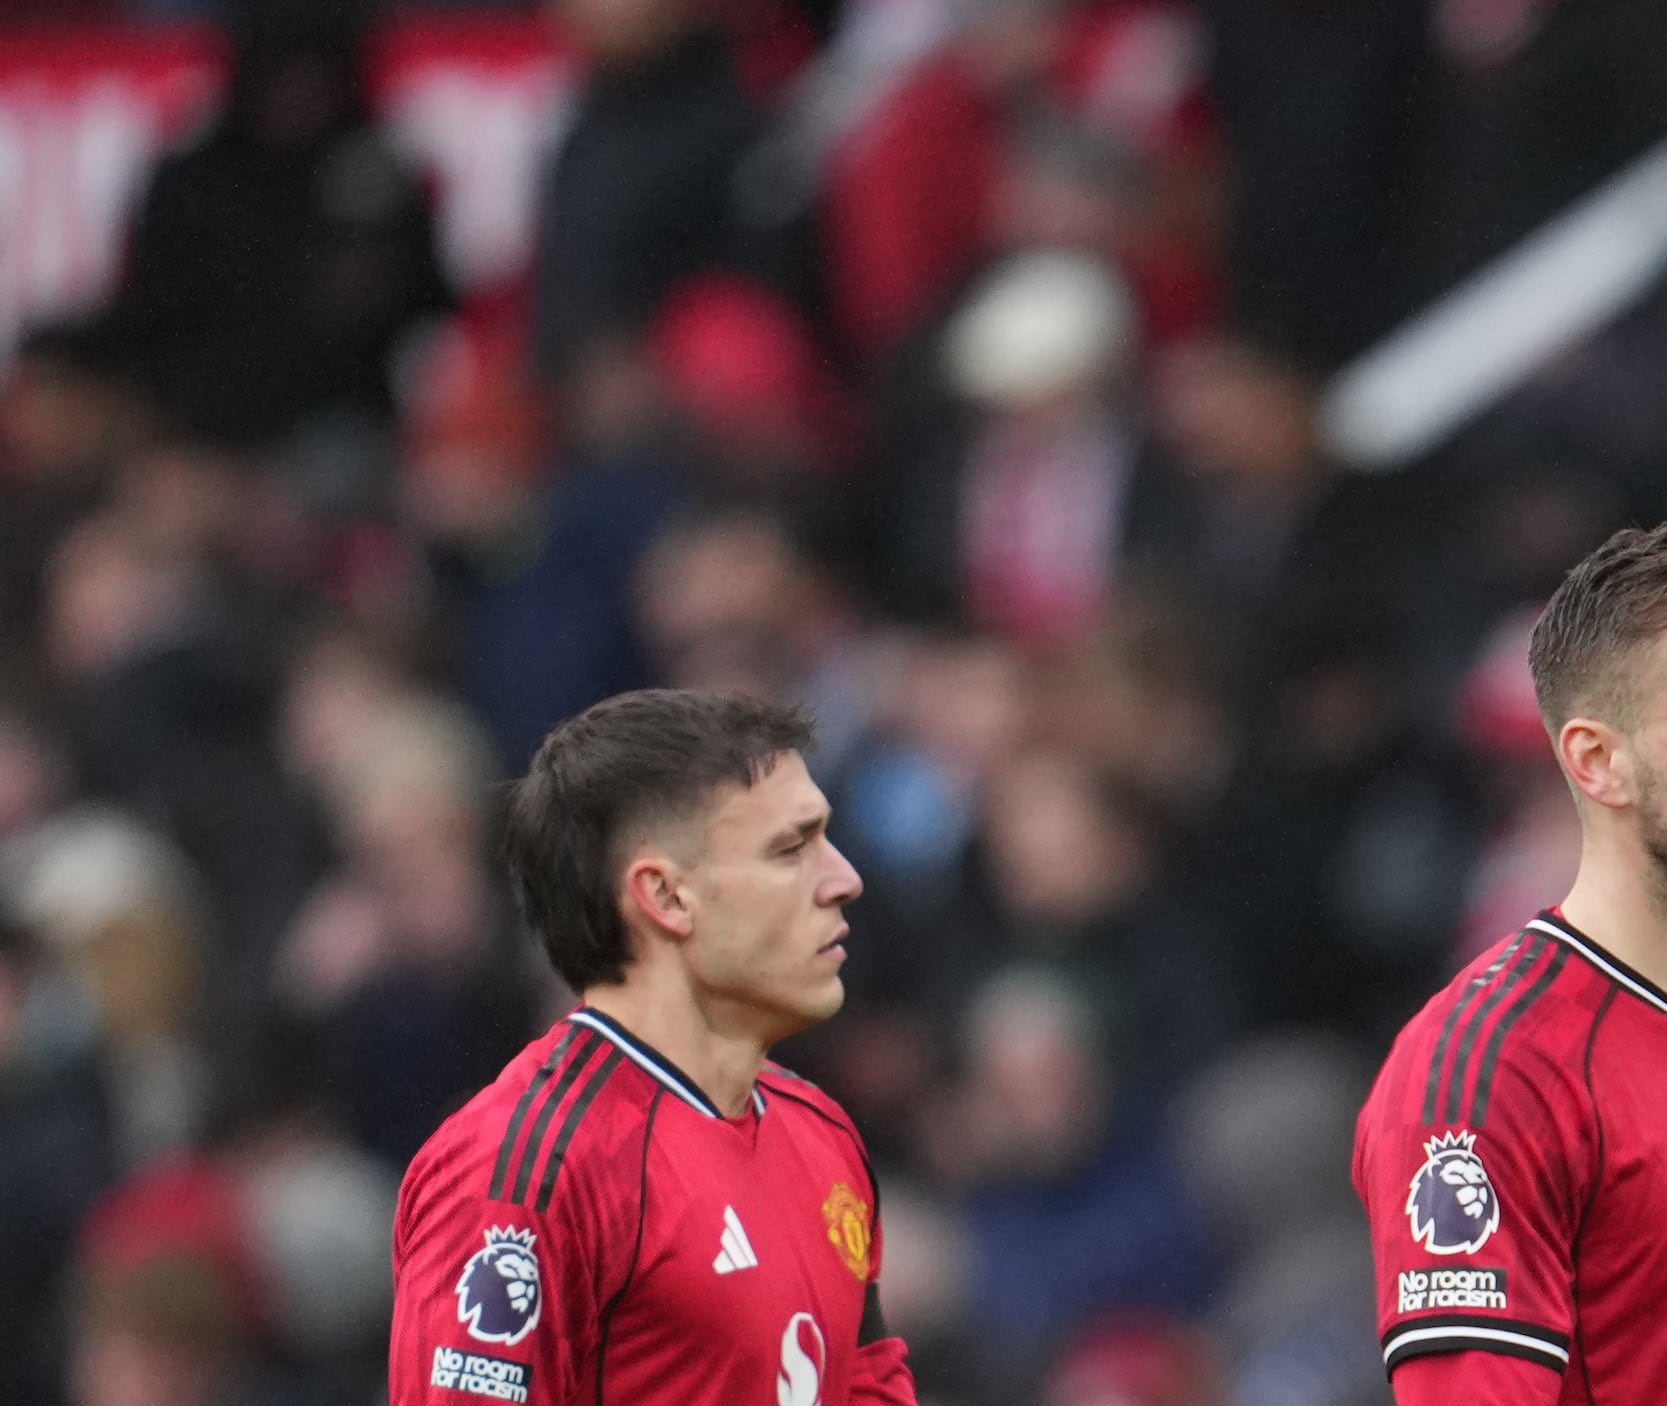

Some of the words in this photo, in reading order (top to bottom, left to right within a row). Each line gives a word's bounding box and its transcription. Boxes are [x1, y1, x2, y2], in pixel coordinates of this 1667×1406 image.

[1398, 1270, 1429, 1292] No
[1431, 1270, 1497, 1290] room
[1397, 1289, 1427, 1314] for
[1428, 1288, 1507, 1309] racism
[433, 1346, 464, 1371] No
[464, 1355, 524, 1384] room
[430, 1367, 460, 1388] for
[459, 1373, 528, 1404] racism
